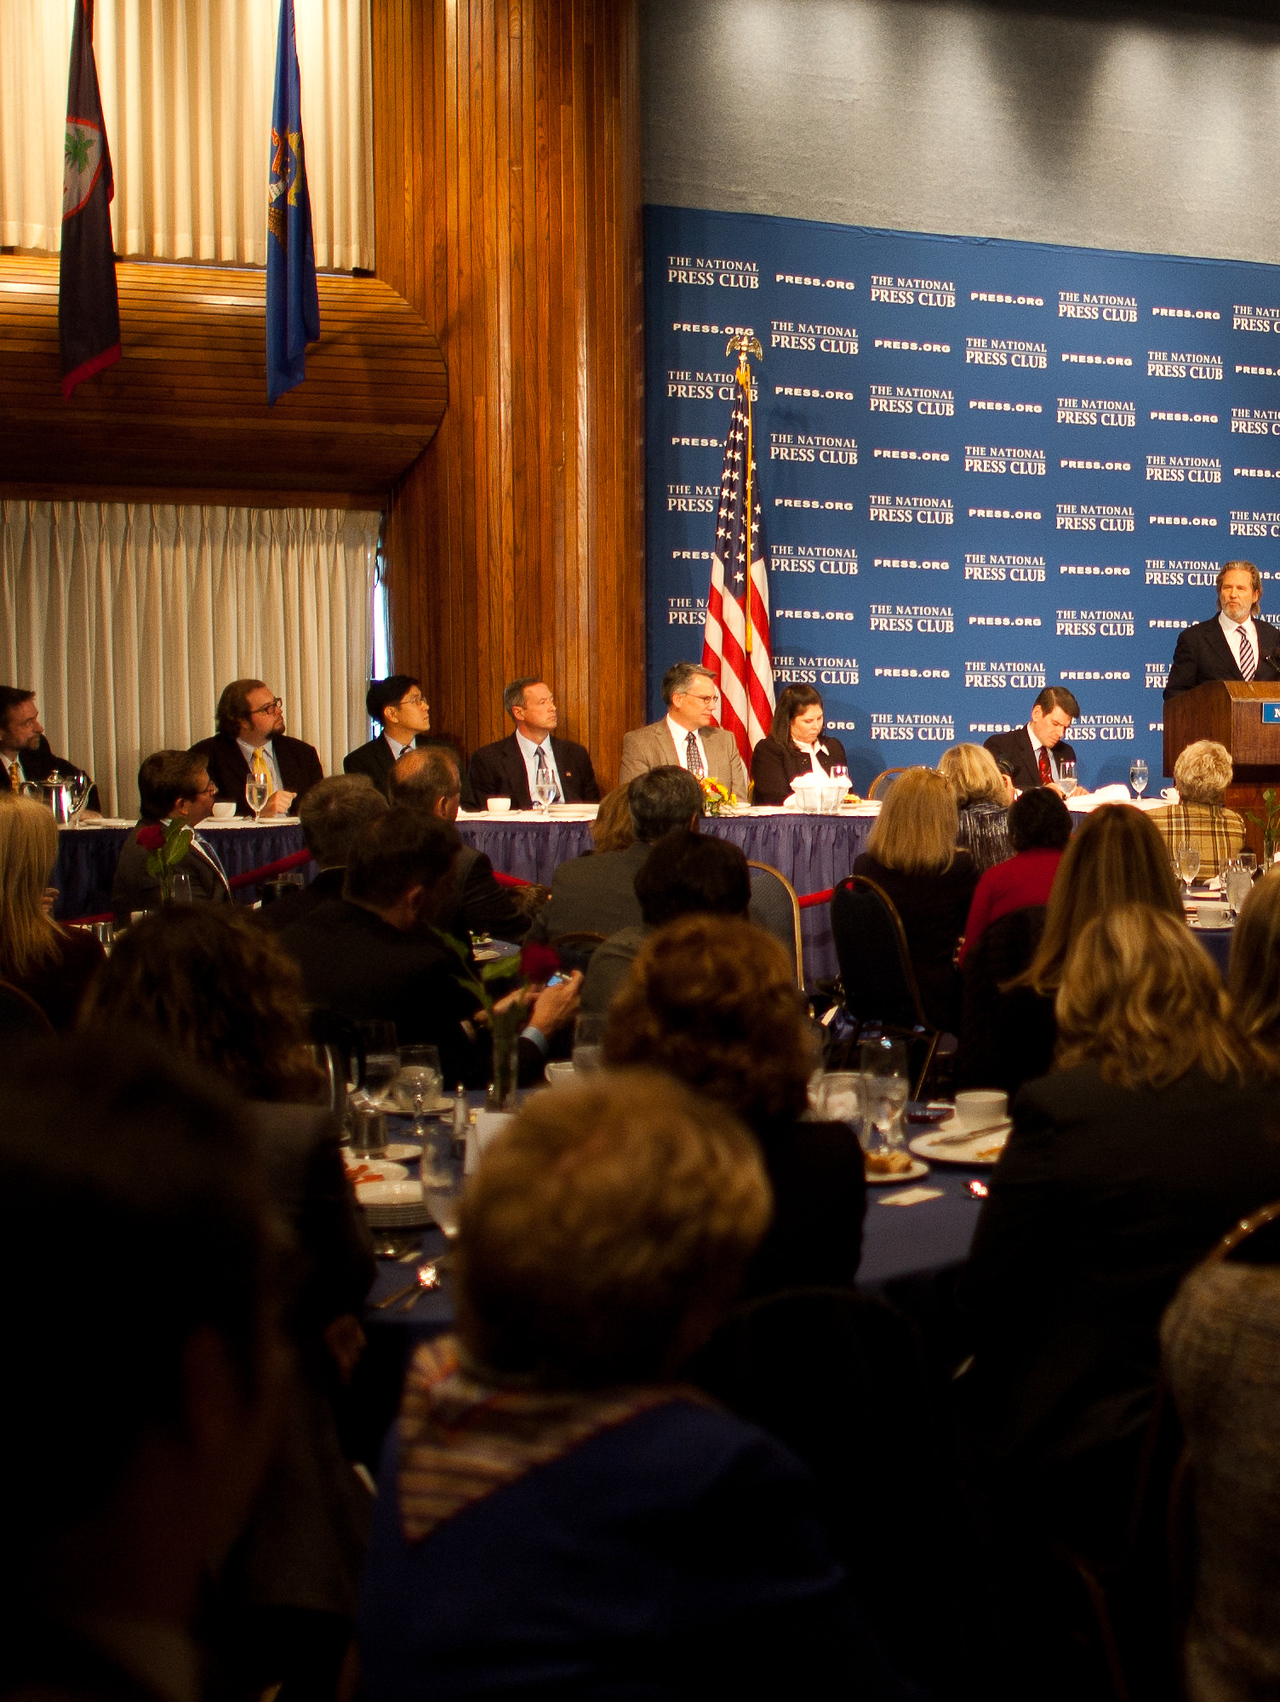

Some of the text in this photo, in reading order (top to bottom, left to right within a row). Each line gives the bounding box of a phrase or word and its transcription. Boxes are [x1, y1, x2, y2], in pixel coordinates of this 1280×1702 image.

[668, 256, 759, 272] THE NATIONAL
[668, 269, 759, 289] PRESS CLUB
[776, 273, 855, 289] PRESS.ORG
[871, 275, 956, 291] THE NATIONAL
[871, 288, 956, 307] PRESS CLUB
[970, 291, 1044, 306] PRESS.ORG
[1059, 291, 1137, 306] THE NATIONAL
[1058, 303, 1137, 322] PRESS CLUB
[1152, 307, 1220, 320] PRESS.ORG
[1233, 305, 1252, 315] THE
[673, 322, 754, 336] PRESS.ORG
[771, 321, 858, 337] THE NATIONAL
[1233, 317, 1270, 332] PRESS
[771, 334, 858, 354] PRESS CLUB
[874, 339, 950, 353] PRESS.ORG
[966, 337, 1047, 352] THE NATIONAL
[966, 350, 1047, 369] PRESS CLUB
[1062, 353, 1132, 366] PRESS.ORG
[1148, 351, 1223, 364] THE NATIONAL
[1147, 363, 1223, 380] PRESS CLUB
[775, 385, 854, 400] PRESS.ORG
[870, 385, 954, 399] THE NATIONAL
[870, 398, 954, 416] PRESS CLUB
[969, 399, 1042, 413] PRESS.ORG
[1057, 398, 1136, 411] THE NATIONAL
[1057, 410, 1136, 427] PRESS CLUB
[1150, 411, 1218, 423] PRESS.ORG
[1231, 408, 1250, 418] THE
[1231, 420, 1268, 434] PRESS
[770, 433, 858, 448] THE NATIONAL
[770, 446, 858, 465] PRESS CLUB
[874, 448, 950, 462] PRESS.ORG
[965, 445, 1046, 459] THE NATIONAL
[964, 458, 1046, 475] PRESS CLUB
[1060, 458, 1131, 471] PRESS.ORG
[1146, 455, 1221, 467] THE NATIONAL
[1146, 467, 1221, 483] PRESS CLUB
[774, 498, 853, 511] PRESS.ORG
[869, 495, 953, 508] THE NATIONAL
[870, 507, 954, 524] PRESS CLUB
[968, 508, 1042, 520] PRESS.ORG
[1056, 504, 1134, 516] THE NATIONAL
[1230, 511, 1249, 520] THE
[1056, 516, 1134, 532] PRESS CLUB
[1150, 515, 1217, 526] PRESS.ORG
[1230, 523, 1267, 536] PRESS
[771, 545, 858, 558] THE NATIONAL
[771, 558, 858, 575] PRESS CLUB
[874, 558, 949, 570] PRESS.ORG
[965, 554, 1046, 565] THE NATIONAL
[964, 566, 1046, 582] PRESS CLUB
[1060, 565, 1130, 575] PRESS.ORG
[776, 609, 854, 621] PRESS.ORG
[870, 604, 954, 616] THE NATIONAL
[1056, 610, 1134, 620] THE NATIONAL
[870, 617, 954, 633] PRESS CLUB
[968, 615, 1042, 626] PRESS.ORG
[1056, 622, 1134, 636] PRESS CLUB
[773, 657, 858, 668] THE NATIONAL
[965, 662, 1046, 672] THE NATIONAL
[773, 670, 859, 685] PRESS CLUB
[874, 668, 950, 678] PRESS.ORG
[1060, 670, 1130, 680] PRESS.ORG
[965, 674, 1046, 688] PRESS CLUB
[871, 714, 954, 724] THE NATIONAL
[871, 726, 954, 740] PRESS CLUB
